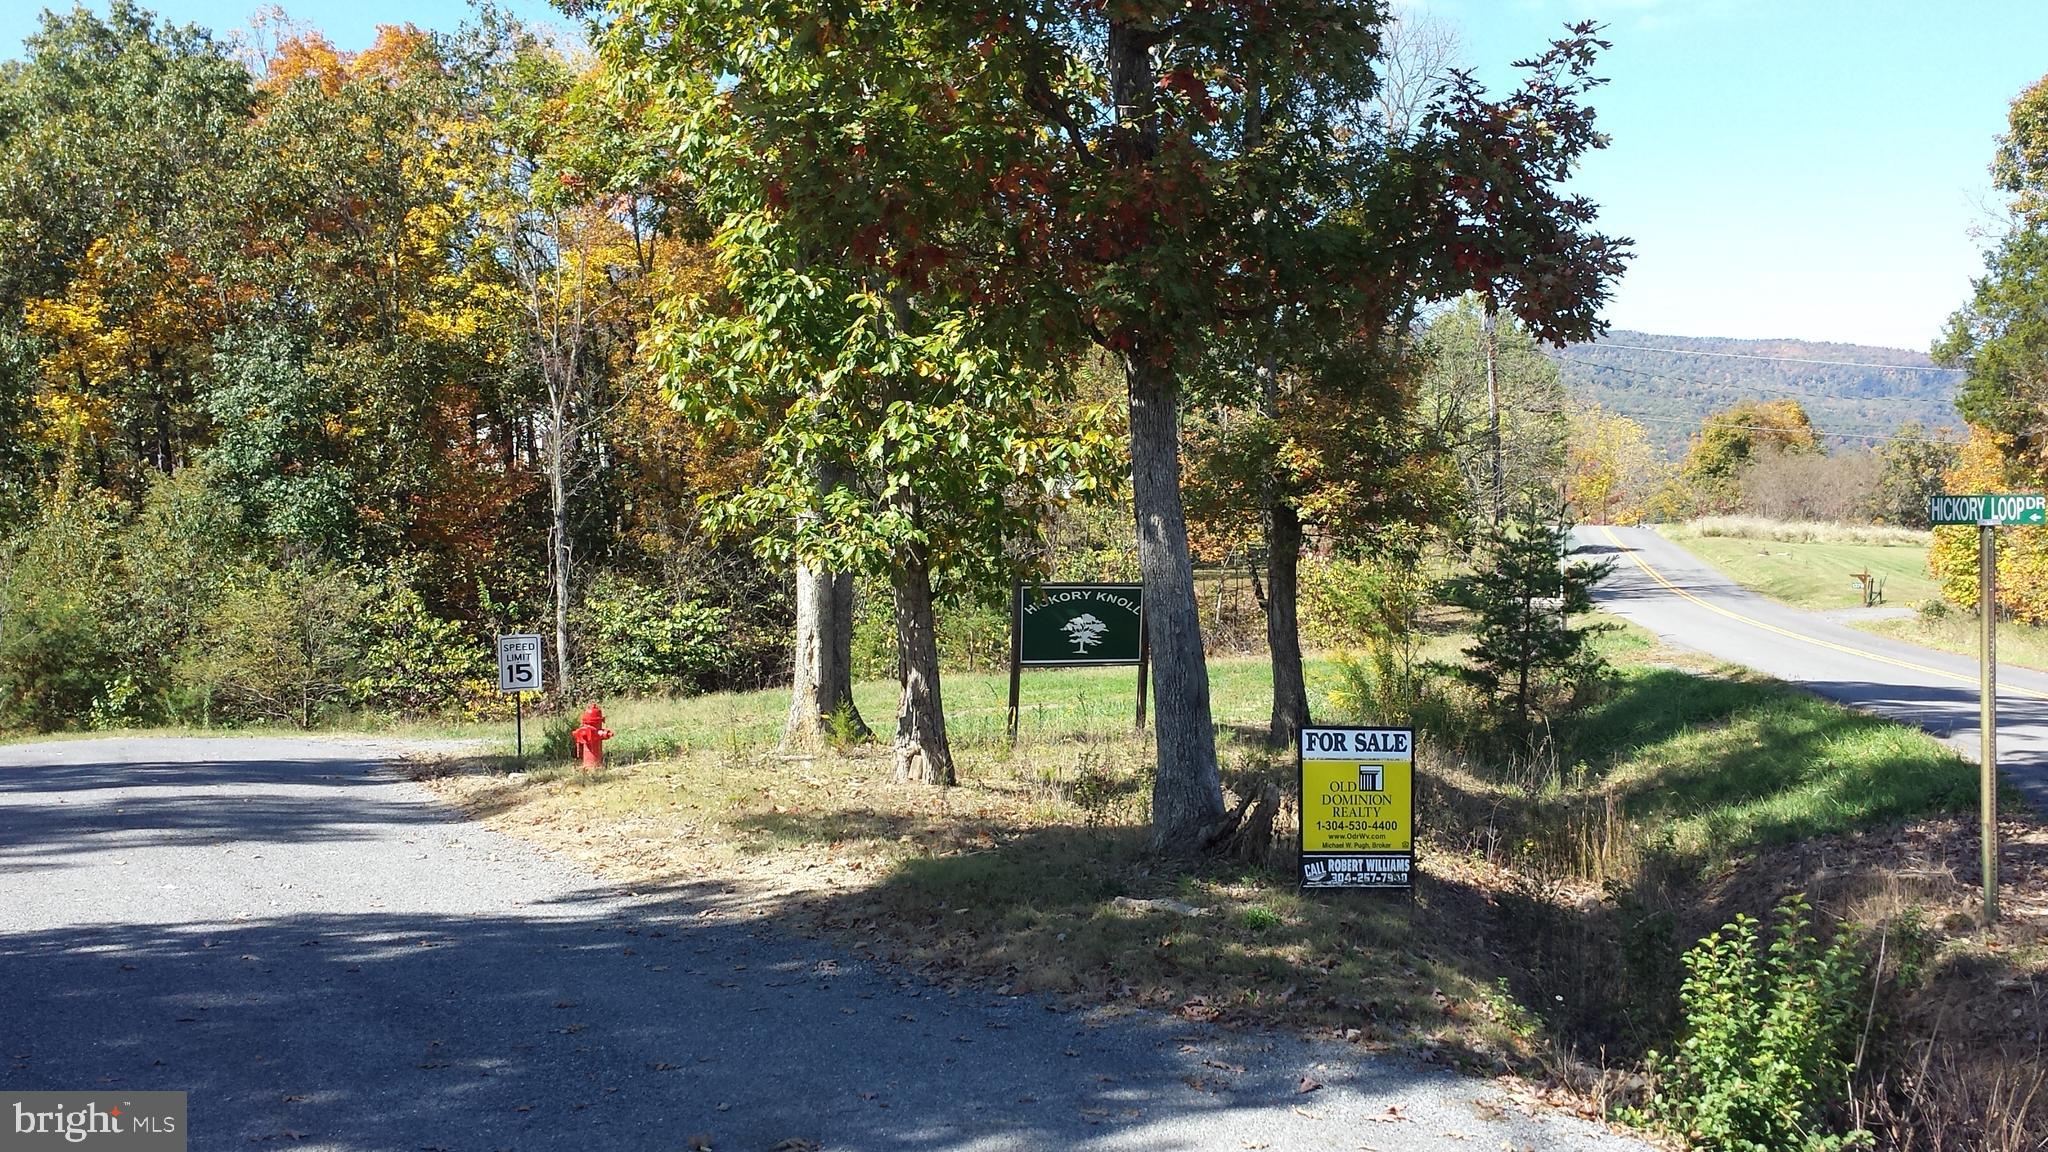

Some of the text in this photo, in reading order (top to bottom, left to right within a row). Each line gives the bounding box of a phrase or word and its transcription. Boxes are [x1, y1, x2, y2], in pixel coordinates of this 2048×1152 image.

[1931, 496, 2046, 521] HICKORY LOOP DR
[1096, 592, 1141, 615] KNOLL
[503, 643, 535, 652] SPEED
[506, 653, 532, 662] LIMIT
[507, 664, 533, 683] 15
[1305, 732, 1408, 753] FOR SALE
[1329, 781, 1357, 792] OLD
[1322, 794, 1392, 805] DOMINION
[1332, 806, 1382, 818] REALTY
[1316, 820, 1398, 831] 1-304-530-4400
[1304, 861, 1327, 877] CALL
[1327, 858, 1411, 873] ROBERT WILLIAMS
